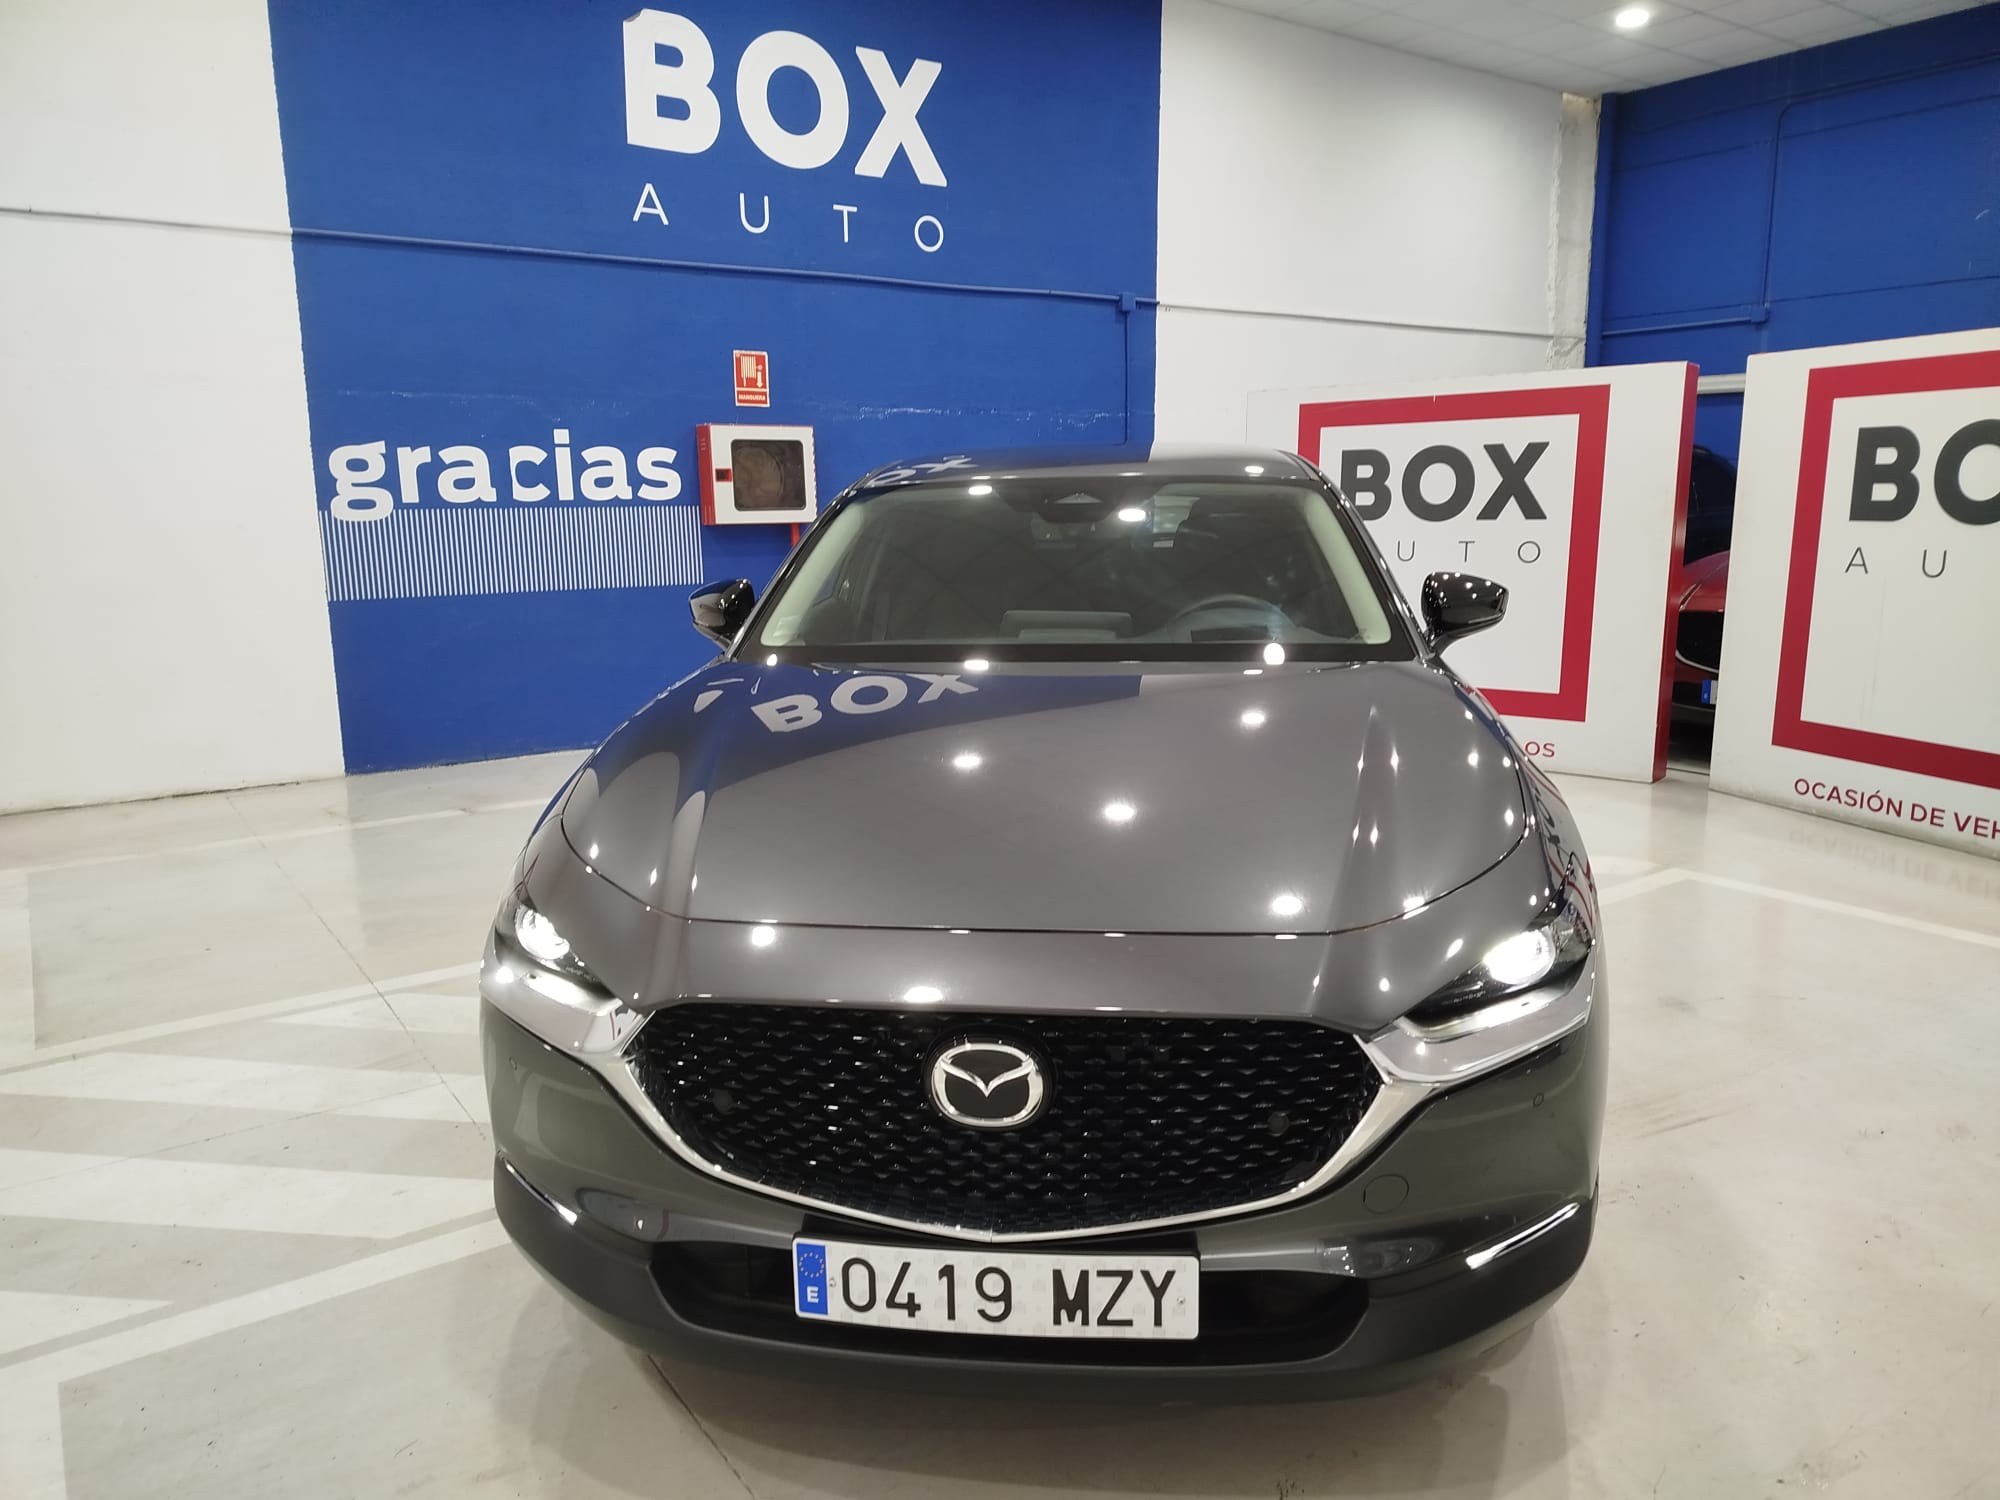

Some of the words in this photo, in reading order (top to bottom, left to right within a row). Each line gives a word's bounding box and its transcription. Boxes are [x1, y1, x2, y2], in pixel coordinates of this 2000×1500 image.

[623, 8, 947, 188] BOX
[633, 183, 945, 253] AUTO
[328, 428, 682, 522] gracias
[1340, 441, 1550, 523] BOX
[1397, 540, 1541, 564] UTO
[1794, 777, 1904, 818] OCASIÓN
[1910, 802, 1946, 828] DE
[806, 1285, 820, 1304] E
[841, 1256, 1013, 1323] 0419
[1051, 1268, 1177, 1329] MZY
